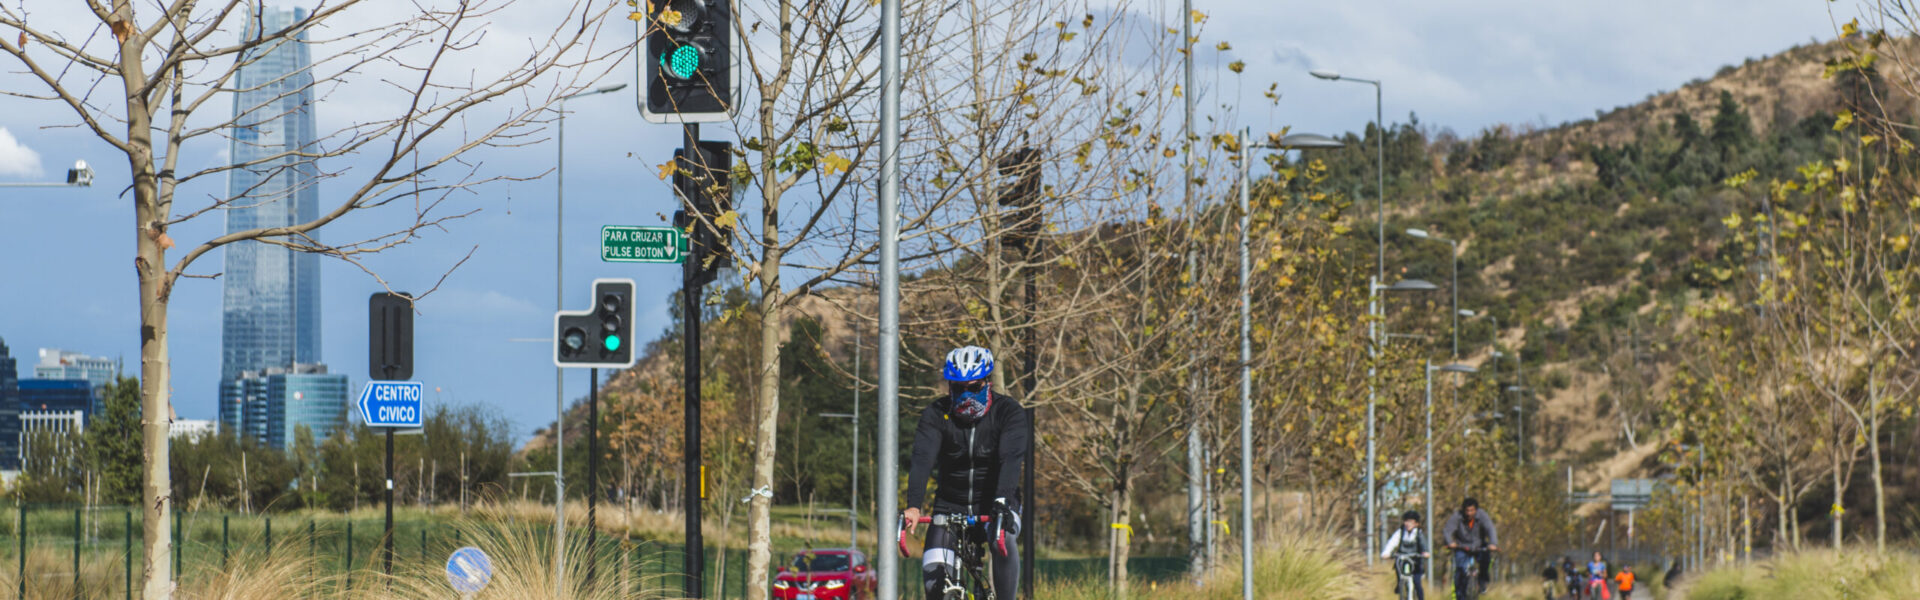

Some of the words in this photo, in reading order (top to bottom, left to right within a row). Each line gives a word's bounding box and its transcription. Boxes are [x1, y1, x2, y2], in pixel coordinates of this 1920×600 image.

[604, 230, 628, 242] PARA
[631, 231, 663, 243] CRUZAR
[604, 246, 631, 257] PULSE
[634, 246, 663, 258] BOTON
[375, 385, 419, 401] CENTRO
[379, 406, 415, 422] CIVICO
